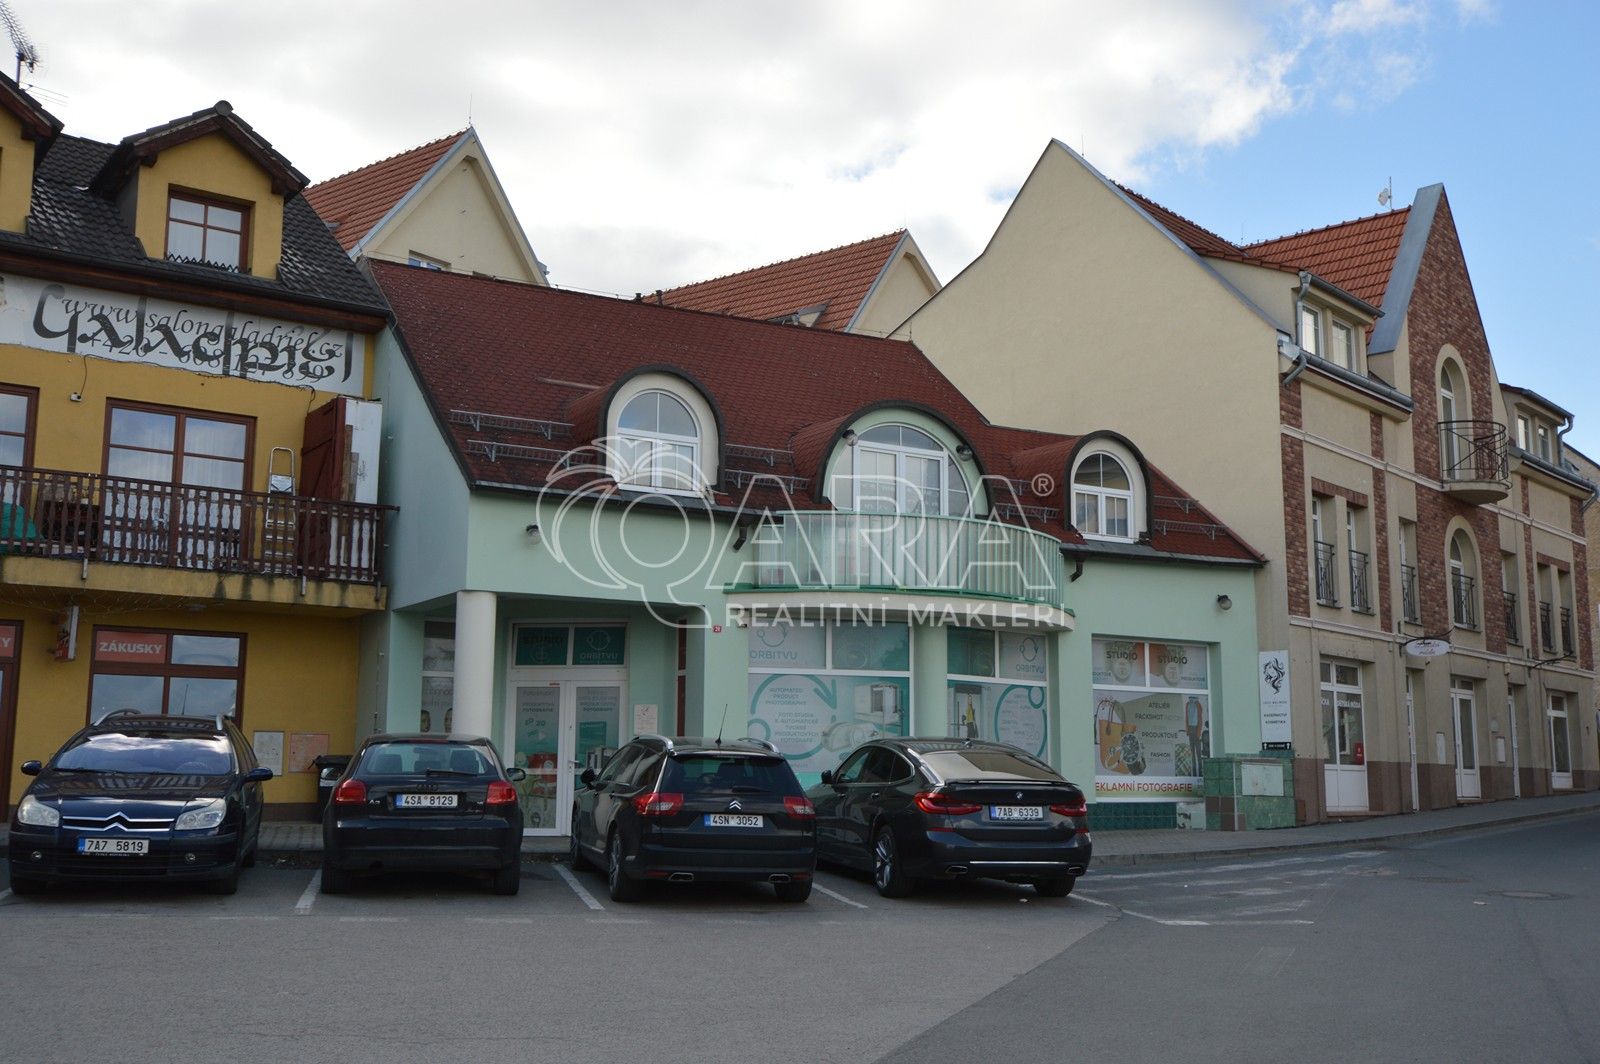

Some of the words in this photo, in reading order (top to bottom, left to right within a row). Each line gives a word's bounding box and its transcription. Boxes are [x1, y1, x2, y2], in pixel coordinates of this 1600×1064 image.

[61, 297, 343, 358] wwwsalongaladriel.cz
[99, 640, 162, 654] ZÁKUSKY
[749, 650, 798, 660] ORBITVU
[1106, 651, 1138, 661] STUDIO
[1158, 655, 1188, 665] STUDIO
[1015, 664, 1045, 674] ORBITVU
[1137, 782, 1193, 792] FOTOGRAFIE
[403, 796, 421, 806] 4SA
[429, 796, 452, 806] 8129
[998, 808, 1012, 817] 7AB
[1018, 808, 1039, 817] 6339
[712, 815, 729, 824] 4SN
[736, 815, 758, 826] 3052
[88, 840, 107, 850] 7A7
[116, 841, 143, 852] 5819
